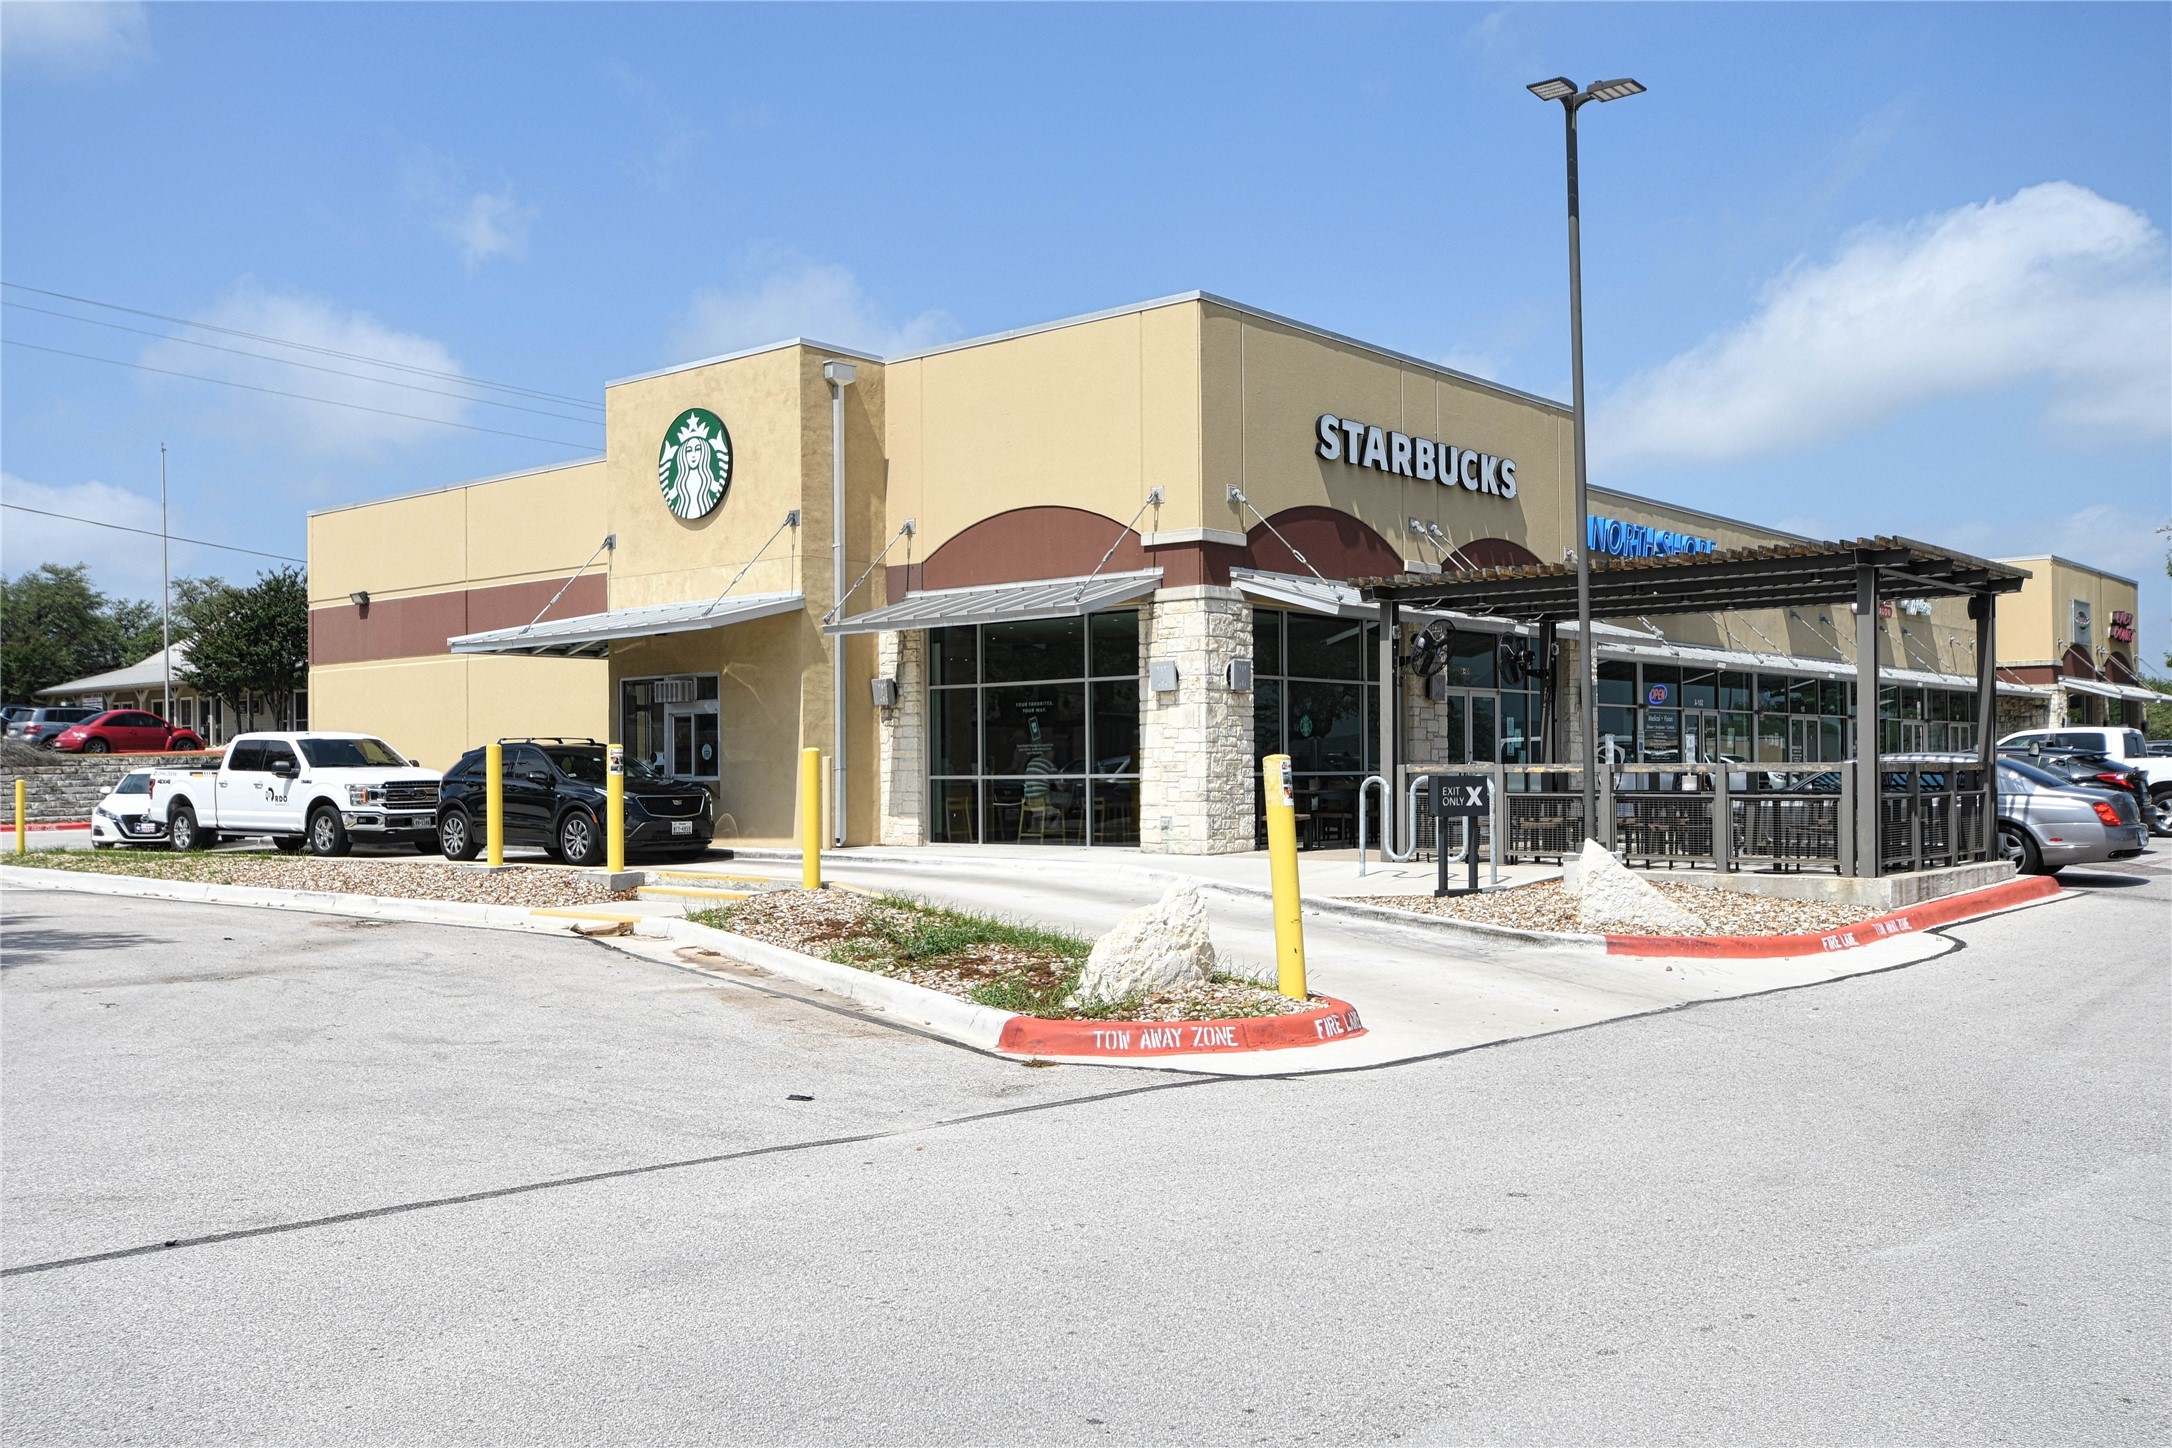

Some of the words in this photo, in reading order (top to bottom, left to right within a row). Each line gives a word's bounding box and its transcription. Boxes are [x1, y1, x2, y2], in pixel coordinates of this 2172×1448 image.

[1315, 413, 1517, 499] STARBUCKS
[1587, 515, 1656, 558] NORTH
[1651, 688, 1665, 700] OPEN
[1442, 786, 1461, 796] EXIT
[1442, 796, 1465, 806] ONLY
[1821, 935, 1842, 952] FIRE
[1314, 1014, 1344, 1040] FIRE
[1093, 1030, 1130, 1050] TOW
[1140, 1028, 1182, 1050] AWAY
[1191, 1026, 1239, 1048] ZONE
